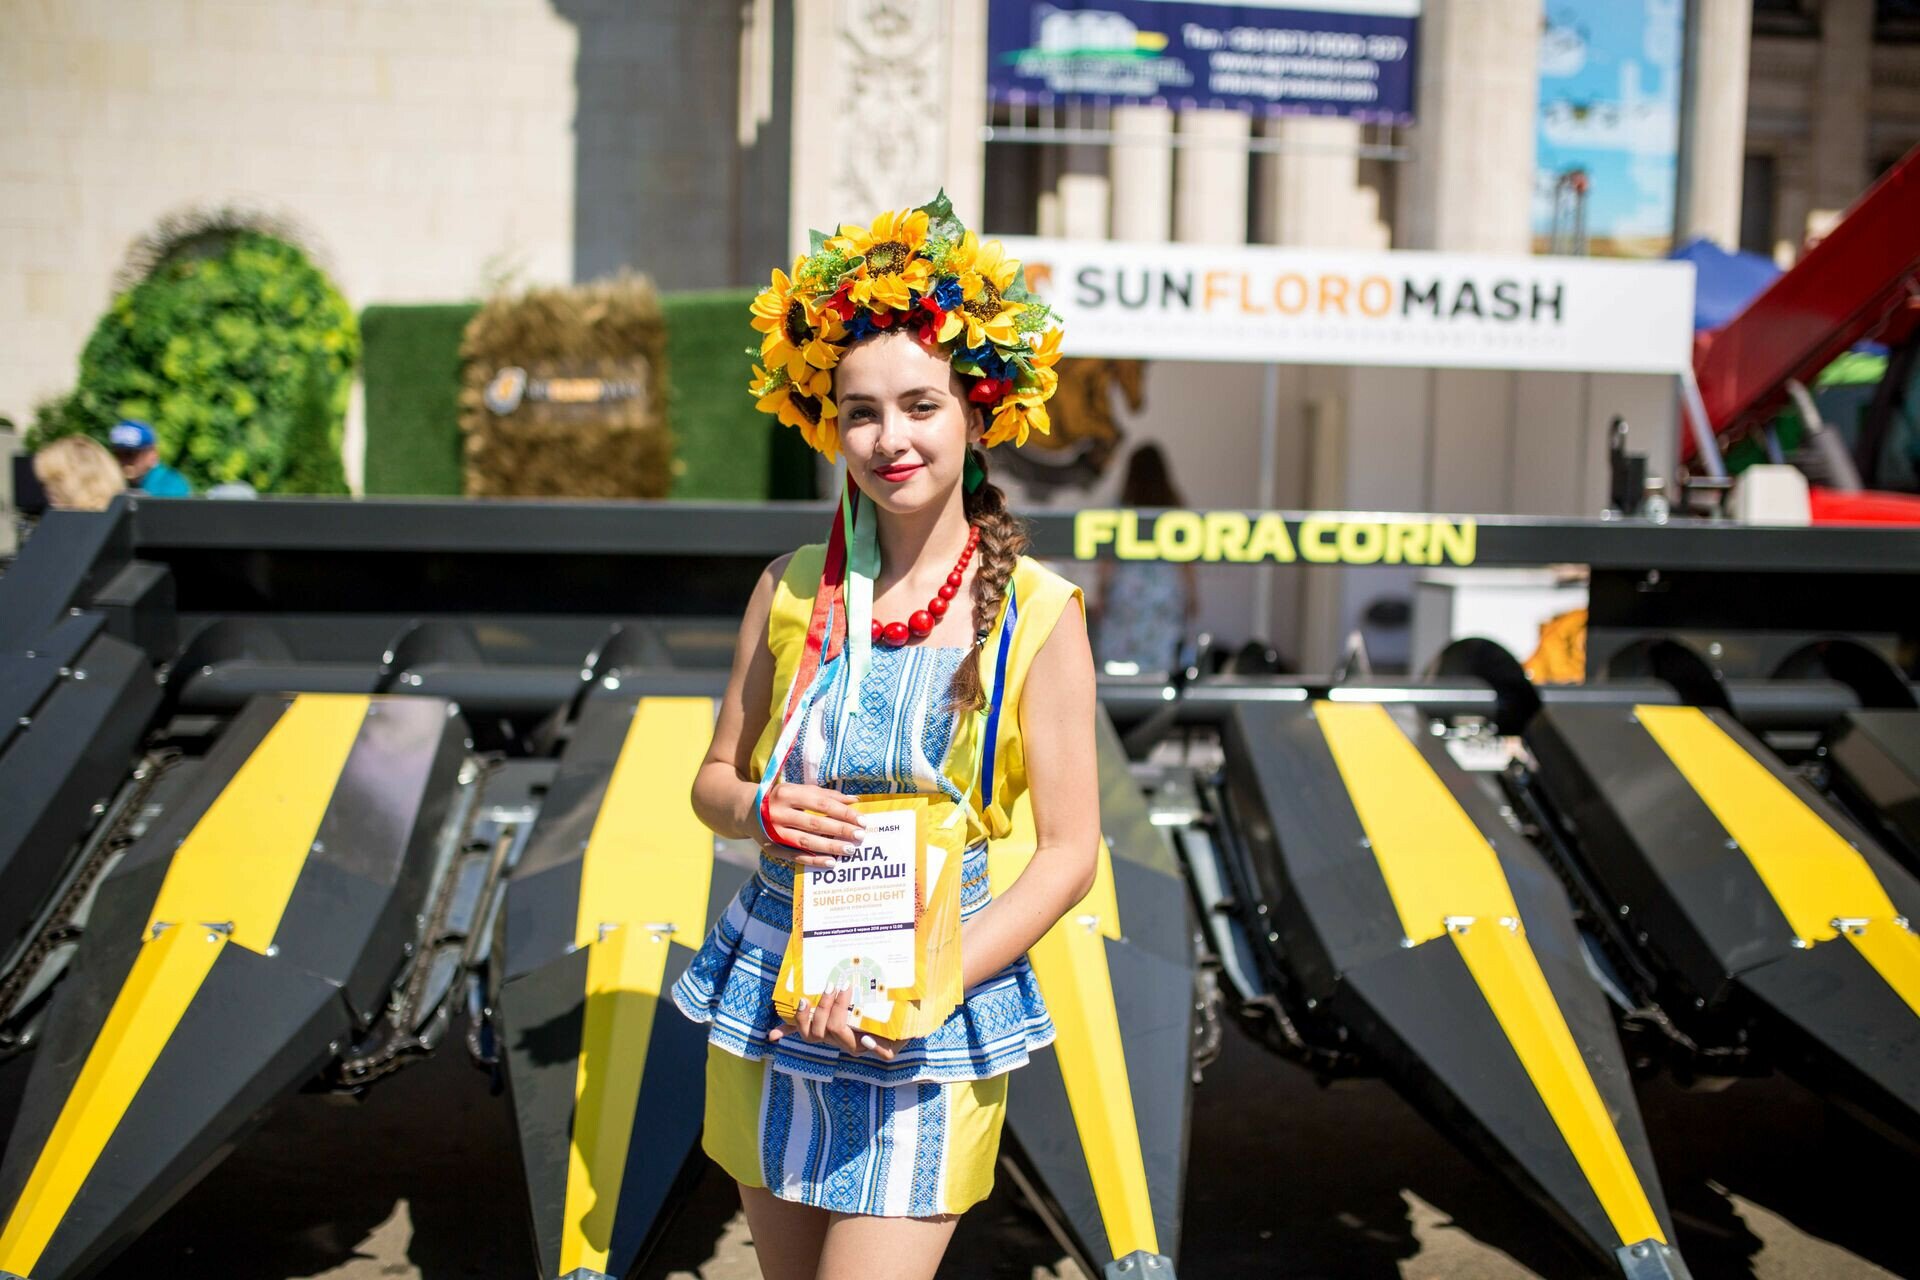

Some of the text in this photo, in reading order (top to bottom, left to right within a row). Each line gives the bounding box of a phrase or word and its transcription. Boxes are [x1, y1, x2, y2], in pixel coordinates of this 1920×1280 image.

[1074, 265, 1564, 324] SUNFLOROMASH
[1074, 509, 1477, 567] FLORA CORN
[812, 863, 906, 885] РОЗІГРАШ!
[812, 890, 906, 907] SUNFLORO LIGHT
